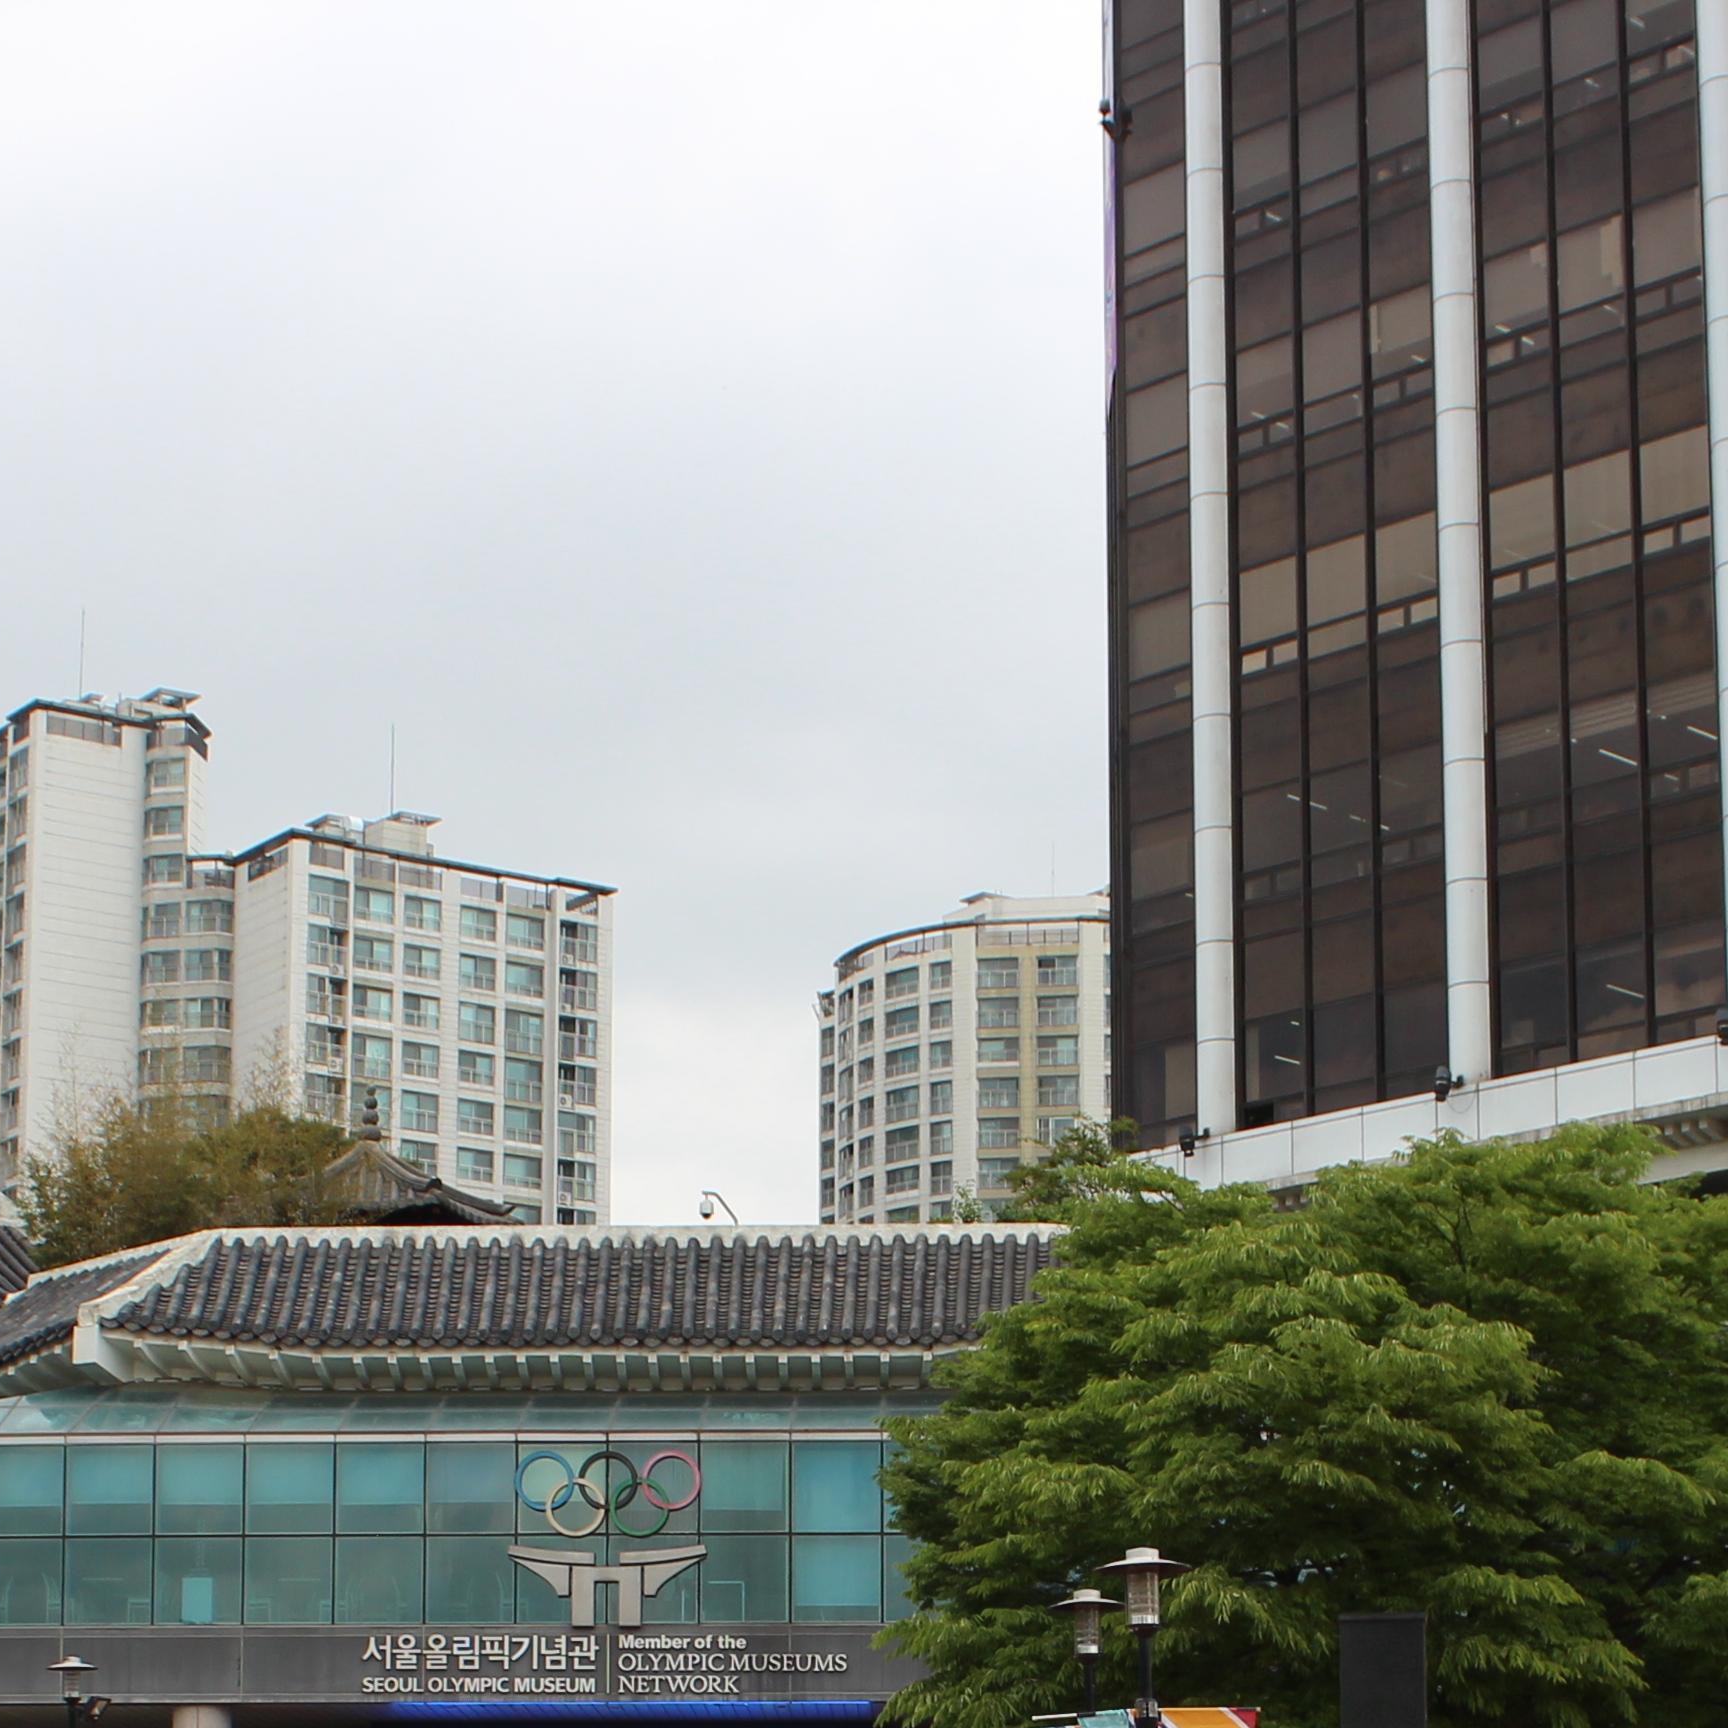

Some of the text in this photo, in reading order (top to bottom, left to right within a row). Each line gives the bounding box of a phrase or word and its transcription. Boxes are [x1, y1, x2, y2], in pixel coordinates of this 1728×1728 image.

[618, 1634, 747, 1649] Member of the
[361, 1633, 600, 1671] 서울올림픽기념관
[618, 1653, 848, 1672] OLYMPIC MUSEUMS
[361, 1676, 596, 1693] SEOUL OLYMPIC MUSEUM
[618, 1675, 740, 1694] NETWORK
